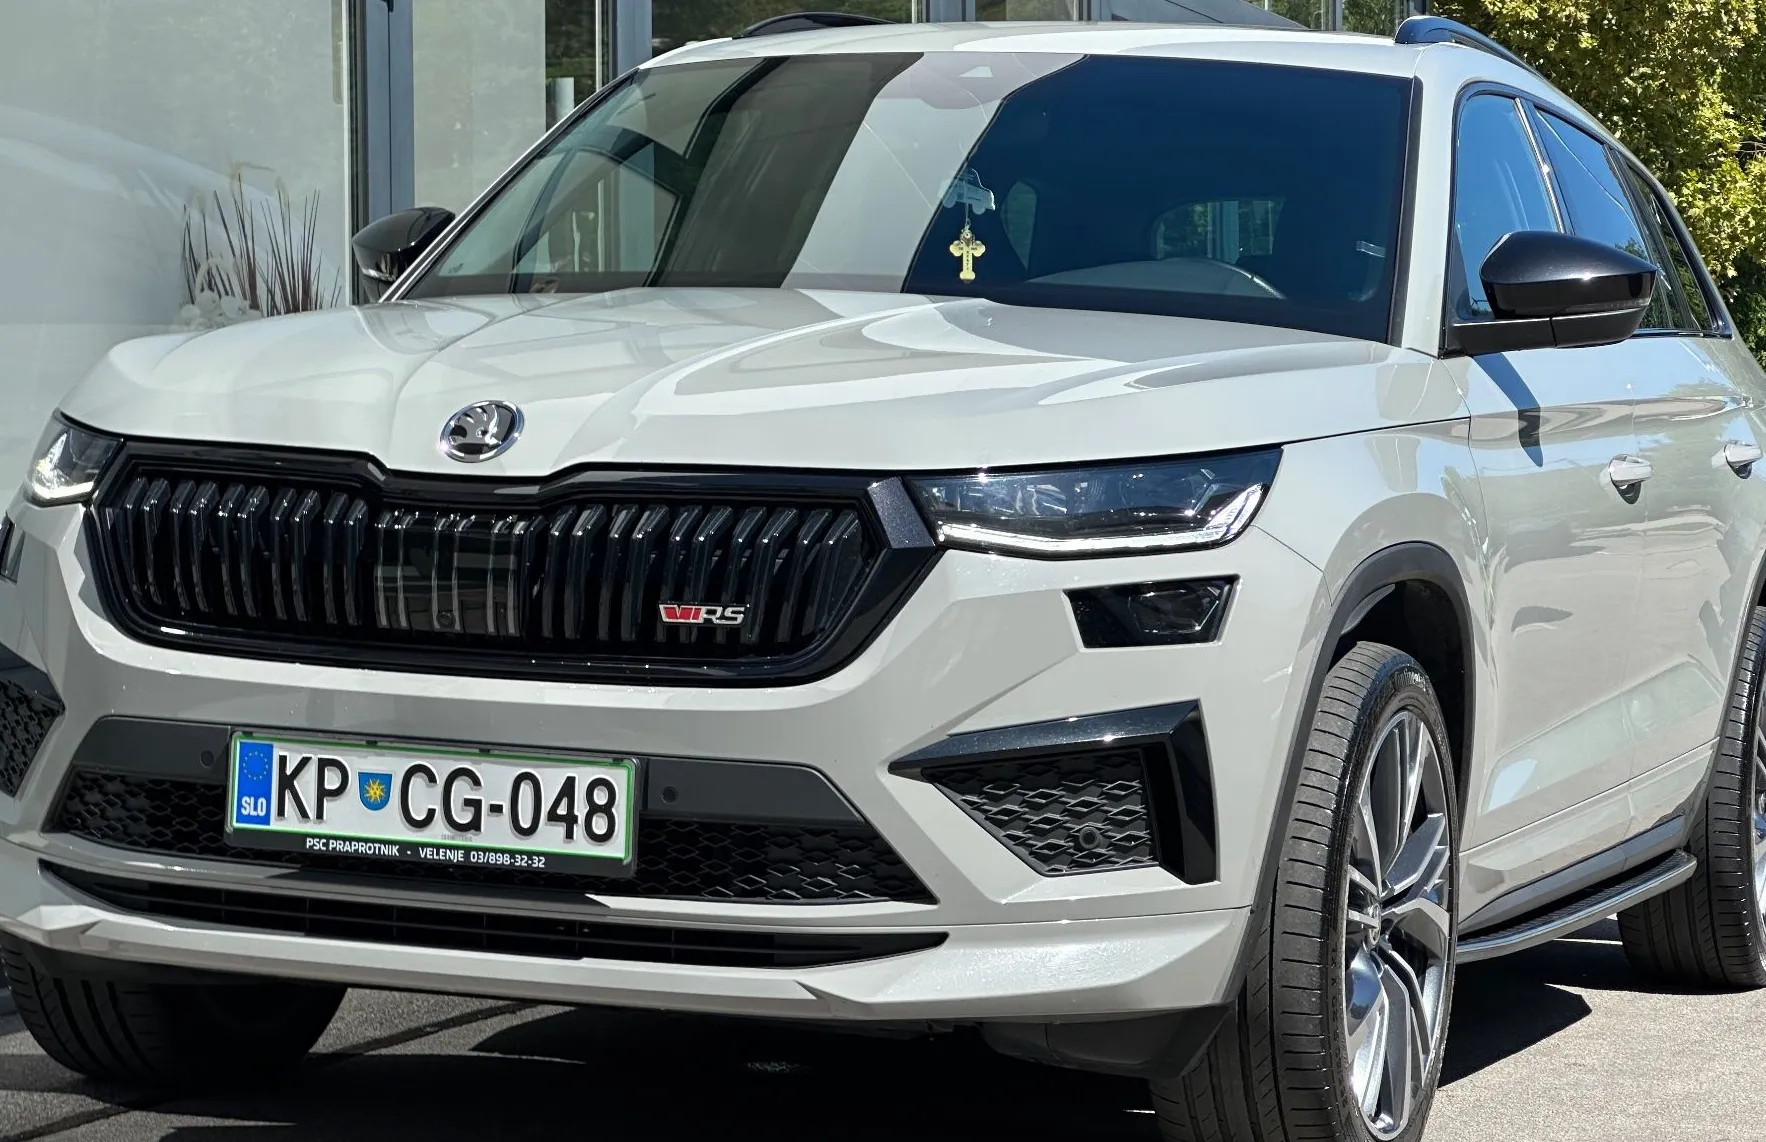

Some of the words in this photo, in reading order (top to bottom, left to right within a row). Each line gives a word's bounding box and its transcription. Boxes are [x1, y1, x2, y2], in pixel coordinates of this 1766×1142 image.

[241, 796, 267, 817] SLO
[277, 754, 350, 820] KP
[400, 763, 616, 843] CG-048
[306, 837, 327, 851] PSC
[329, 839, 400, 857] PRAPROTNIK
[419, 847, 465, 863] VELENJE
[470, 851, 546, 868] 03/898-32-32
